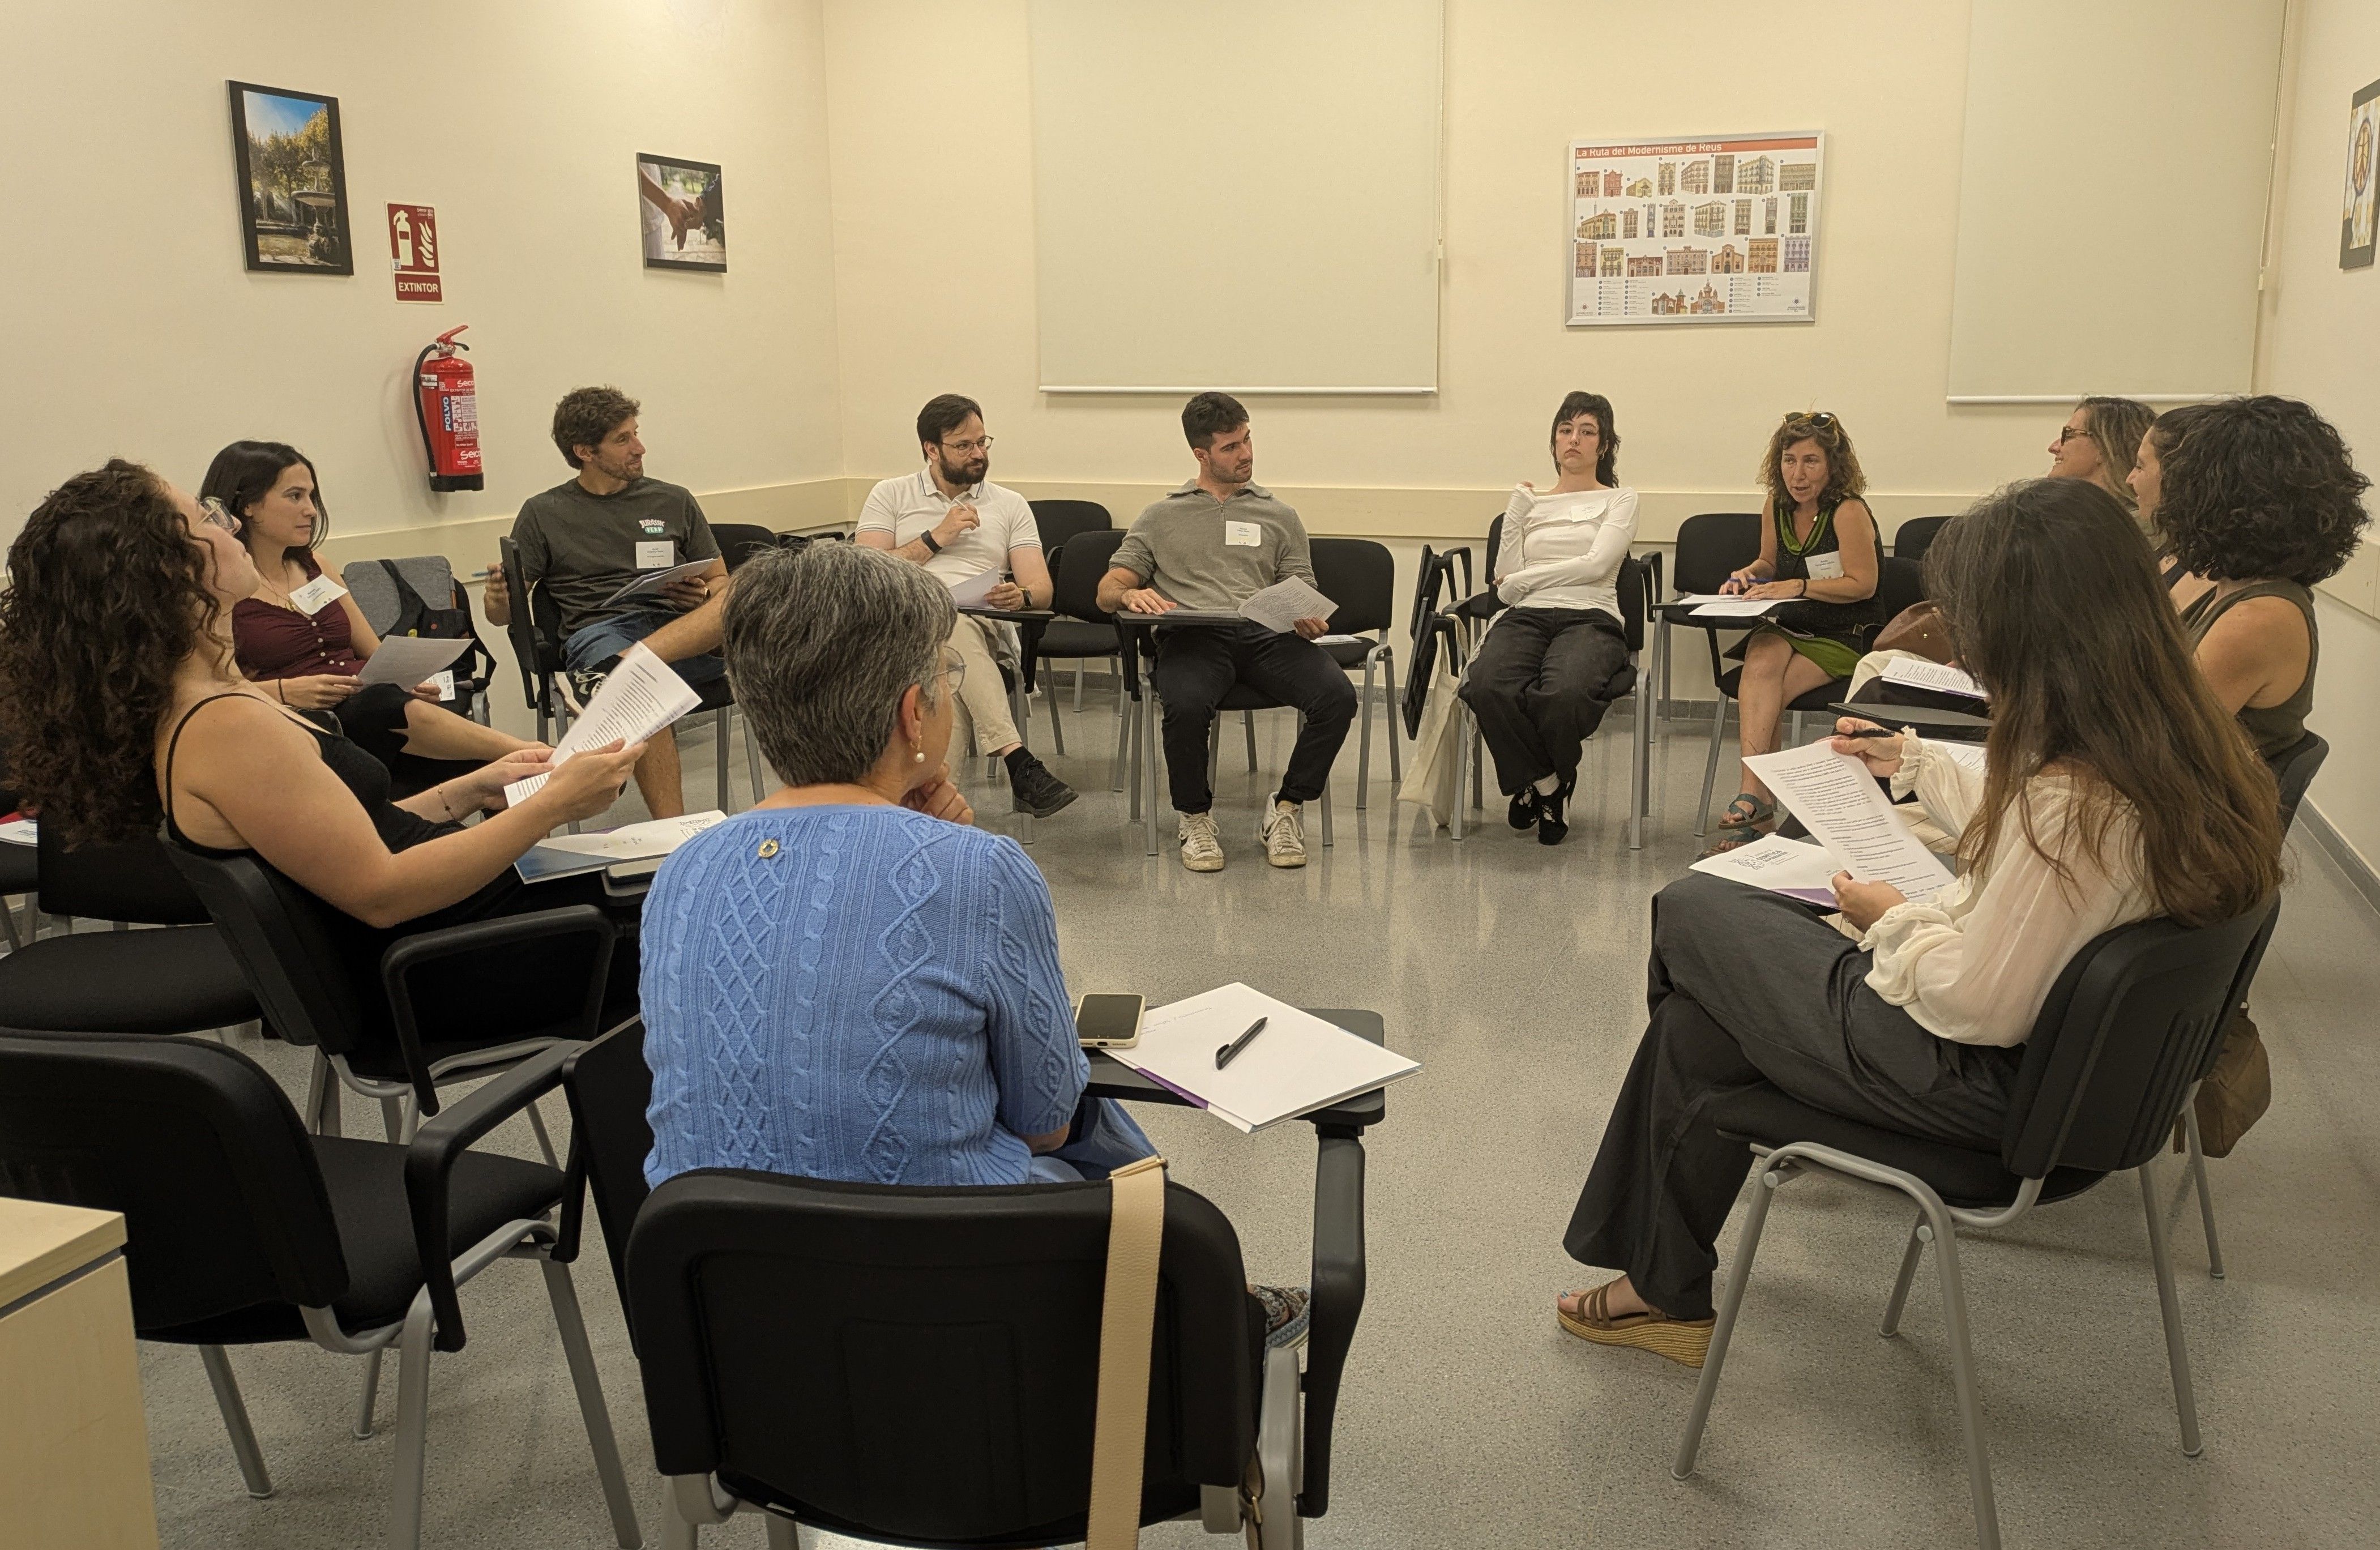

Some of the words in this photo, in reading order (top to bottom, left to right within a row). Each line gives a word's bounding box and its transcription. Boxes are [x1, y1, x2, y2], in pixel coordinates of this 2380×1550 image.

[1576, 149, 1586, 157] La
[1589, 148, 1609, 157] Ruta
[1612, 147, 1626, 156] del
[1627, 145, 1683, 155] Modernisme
[1686, 144, 1697, 152] de
[1699, 143, 1722, 152] Reus
[398, 282, 439, 293] EXTINTOR
[443, 396, 452, 431] POLVO
